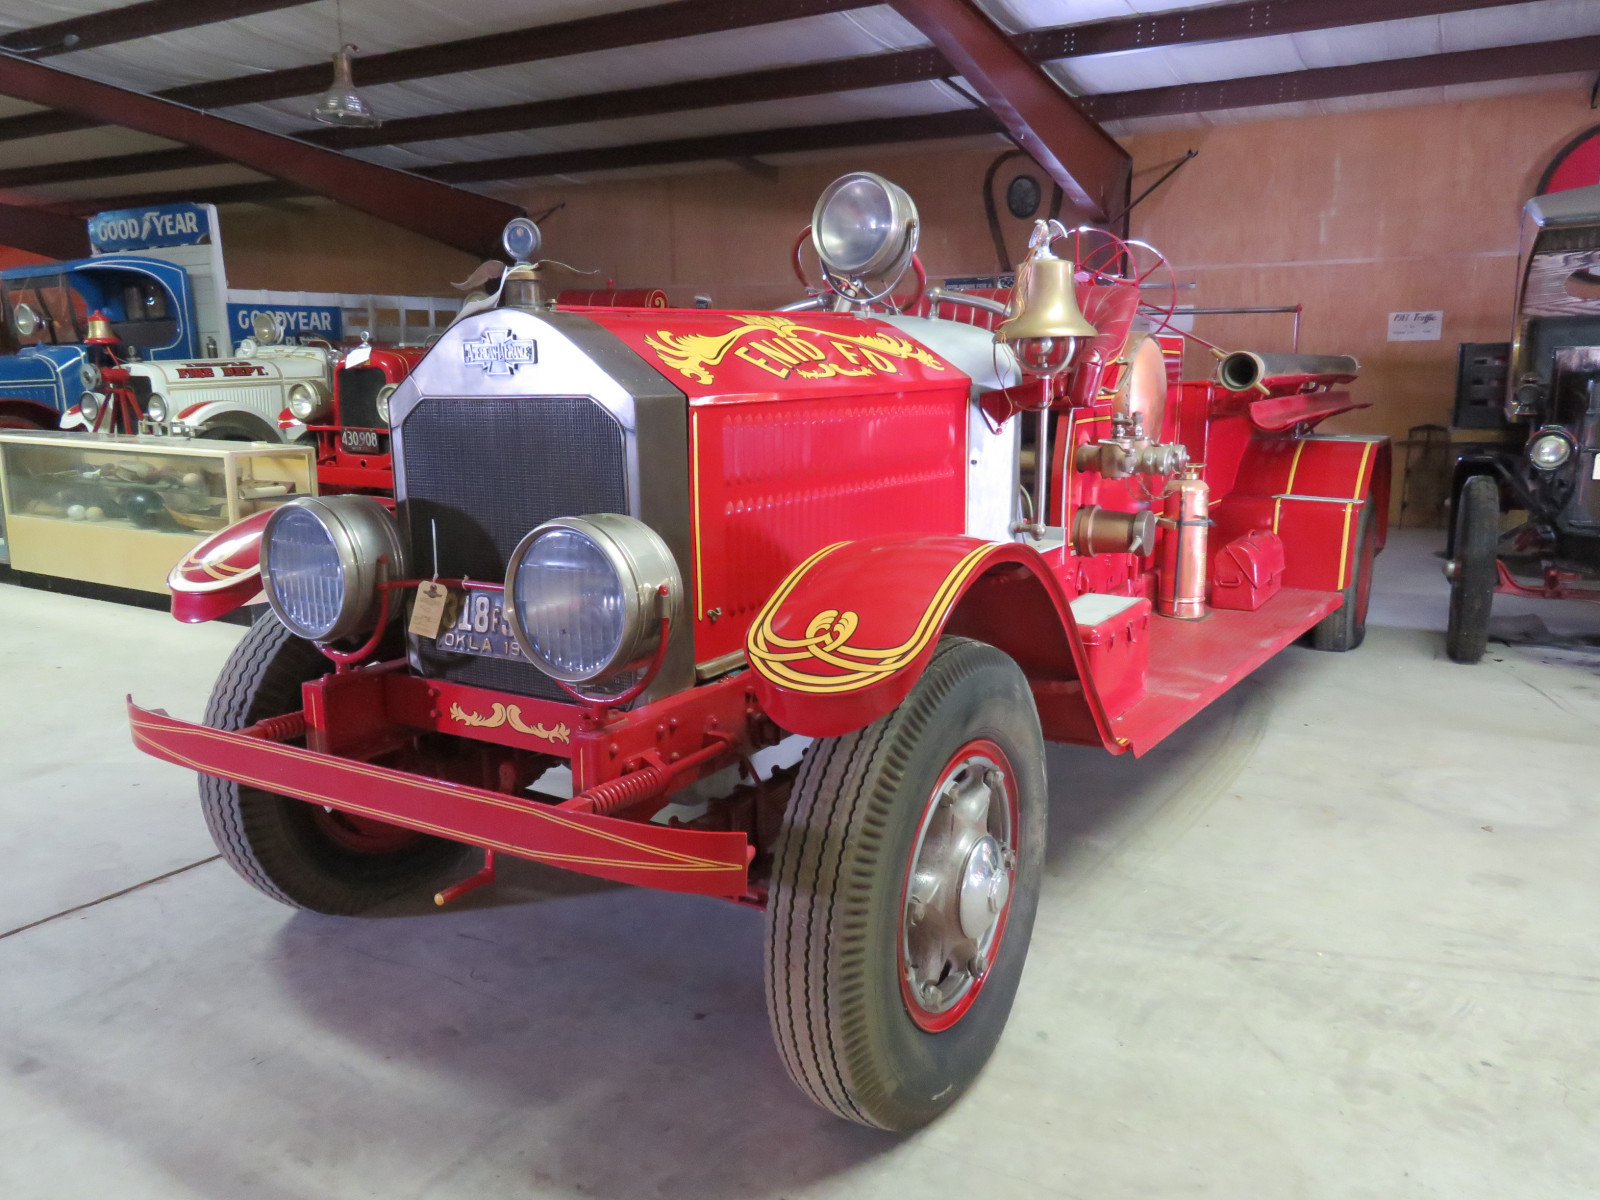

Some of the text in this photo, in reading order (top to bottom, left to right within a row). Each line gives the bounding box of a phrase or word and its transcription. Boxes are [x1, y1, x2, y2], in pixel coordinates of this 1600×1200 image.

[733, 337, 828, 380] ENID
[176, 366, 269, 378] FIRE DEPT.
[444, 633, 493, 653] OKLA
